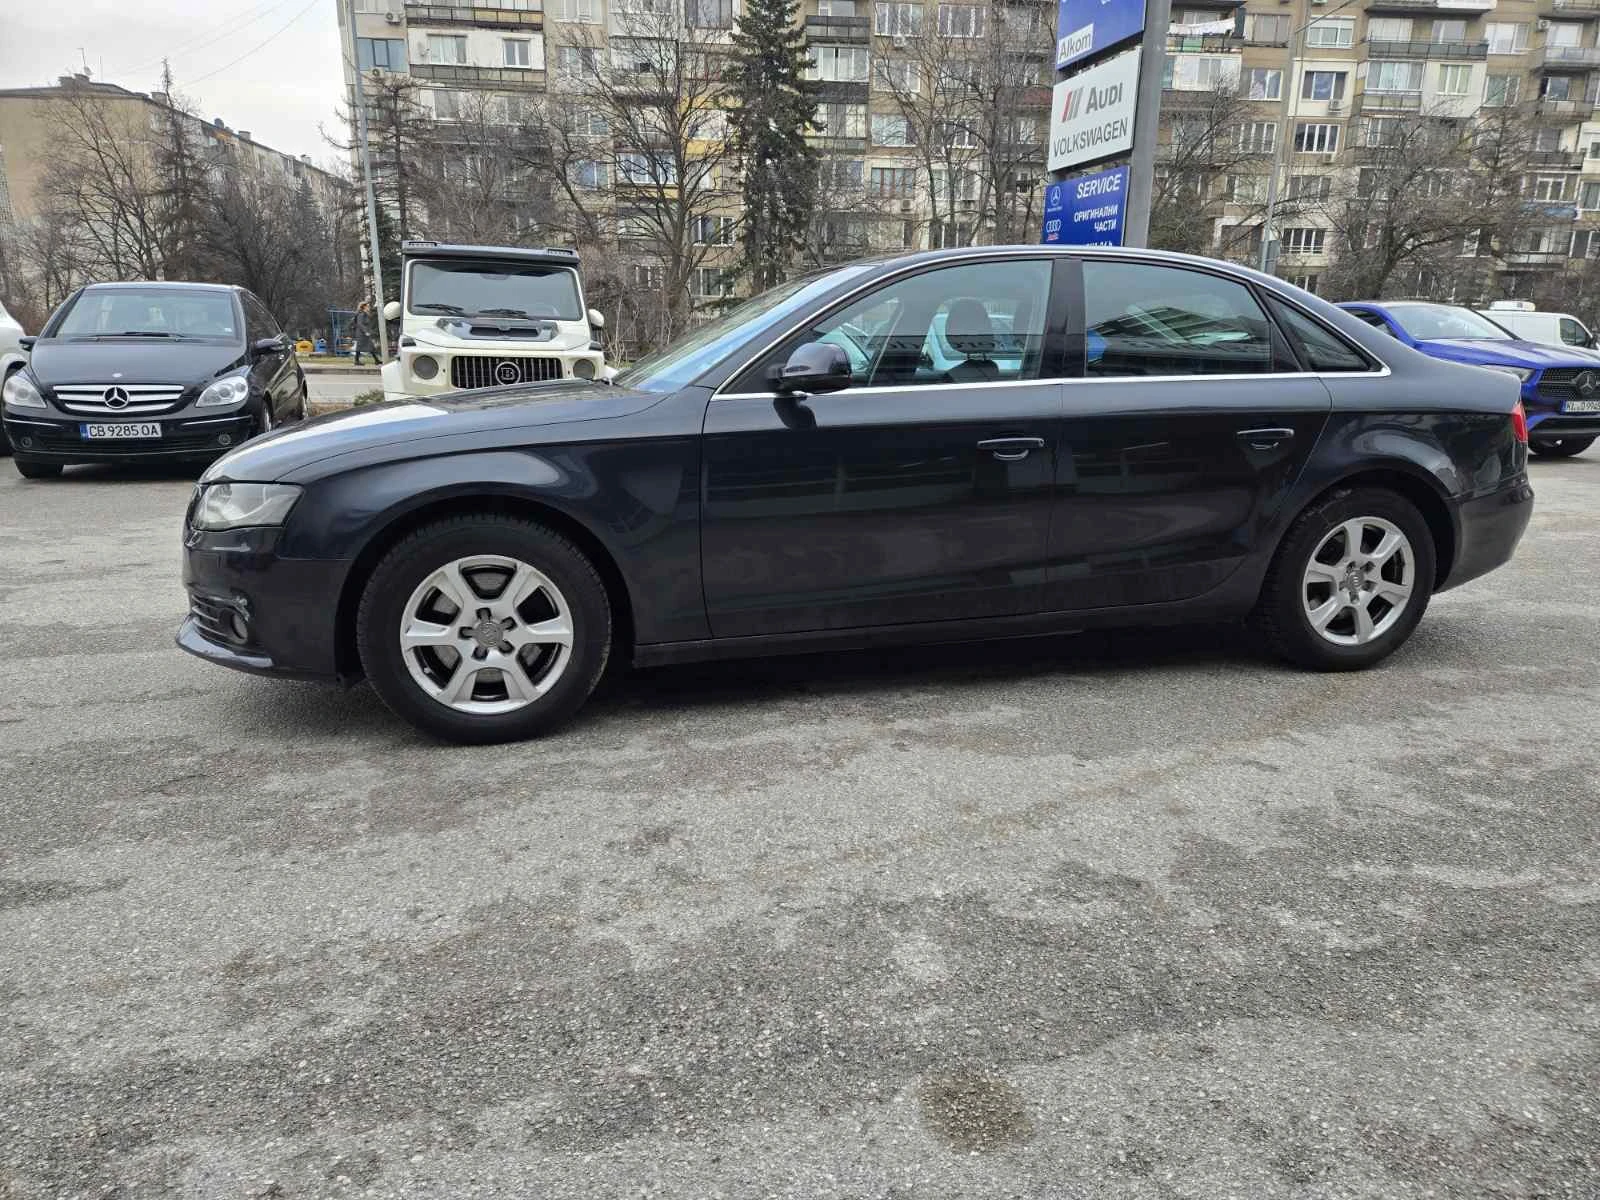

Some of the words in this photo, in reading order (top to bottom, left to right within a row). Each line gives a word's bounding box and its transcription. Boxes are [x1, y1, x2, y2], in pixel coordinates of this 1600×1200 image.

[1060, 33, 1091, 57] Alkom
[1085, 82, 1123, 114] AUDI
[1053, 117, 1128, 157] VOLKSWAGEN
[1076, 174, 1122, 199] SERVICE
[1074, 204, 1119, 222] ОРИГИНАЛНИ
[1094, 219, 1117, 232] ЧАСТИ
[107, 425, 139, 437] 9285
